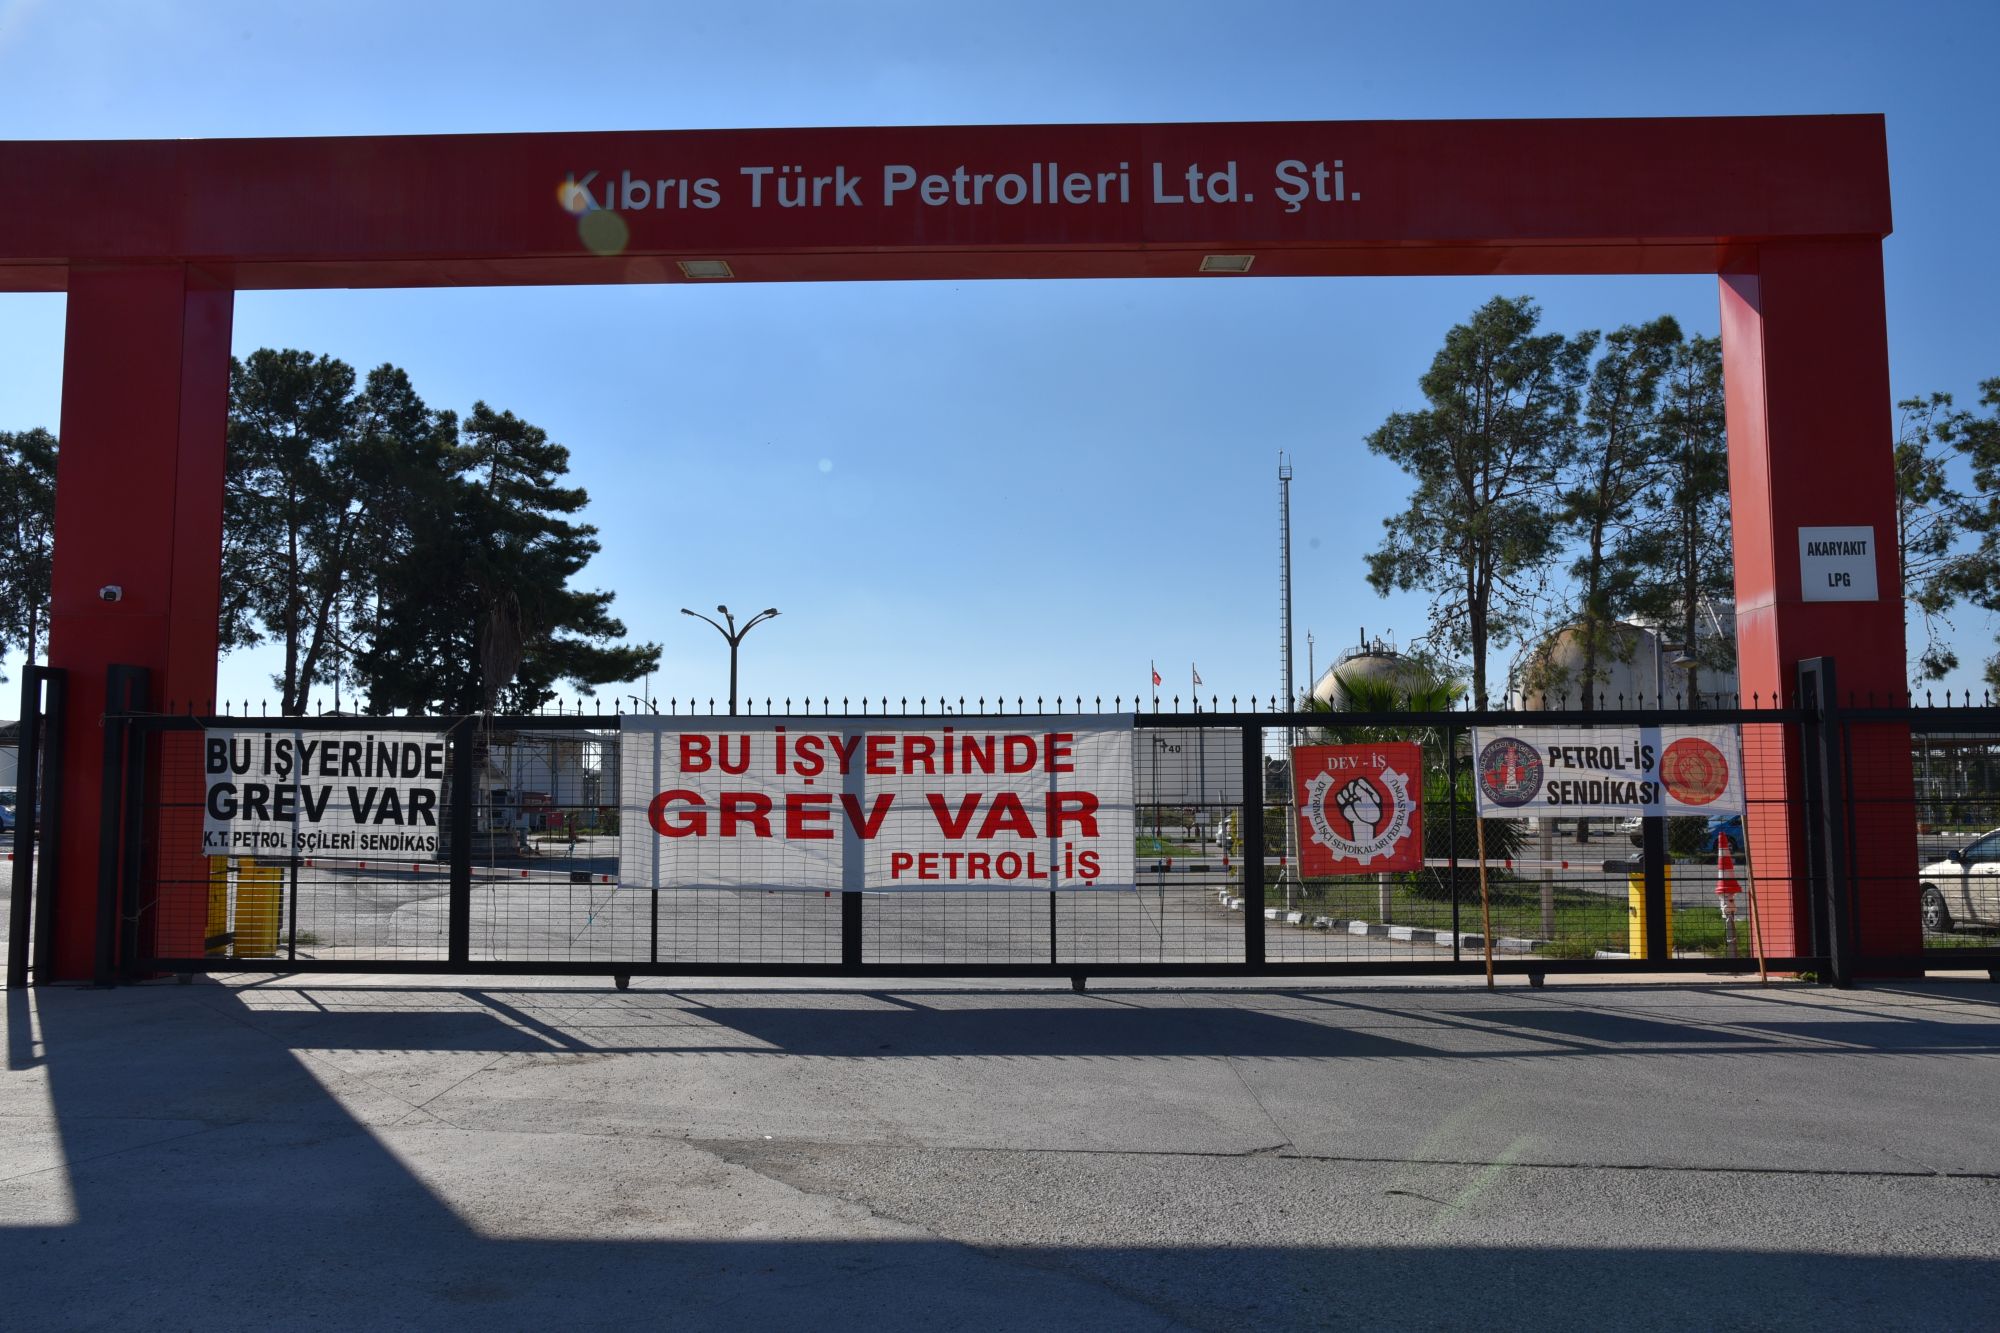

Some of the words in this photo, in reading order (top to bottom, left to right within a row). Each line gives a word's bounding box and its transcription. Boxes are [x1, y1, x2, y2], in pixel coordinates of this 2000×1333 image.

[565, 168, 721, 211] Kıbrıs
[741, 165, 864, 210] Türk
[884, 162, 1131, 208] Petrolleri
[1153, 160, 1255, 205] Ltd.
[1274, 158, 1363, 213] Şti.
[1807, 541, 1867, 556] AKARYAKIT
[1828, 572, 1851, 587] LPG
[207, 738, 251, 775] BU
[263, 733, 444, 782] İŞYERİNDE
[679, 734, 750, 774] BU
[775, 726, 1075, 784] İŞYERİNDE
[1548, 740, 1655, 773] PETROL-İŞ
[207, 782, 332, 823] GREV
[347, 786, 437, 826] VAR
[1387, 779, 1405, 841] FEDERASYONU
[1546, 776, 1660, 805] SENDİKASI
[648, 789, 895, 839] GREV
[925, 791, 1101, 839] VAR
[203, 831, 229, 848] K.T.
[233, 832, 287, 849] PETROL
[292, 829, 355, 854] İŞÇİLERİ
[360, 832, 439, 852] SENDİKASI
[891, 842, 1101, 887] PETROL-İŞ
